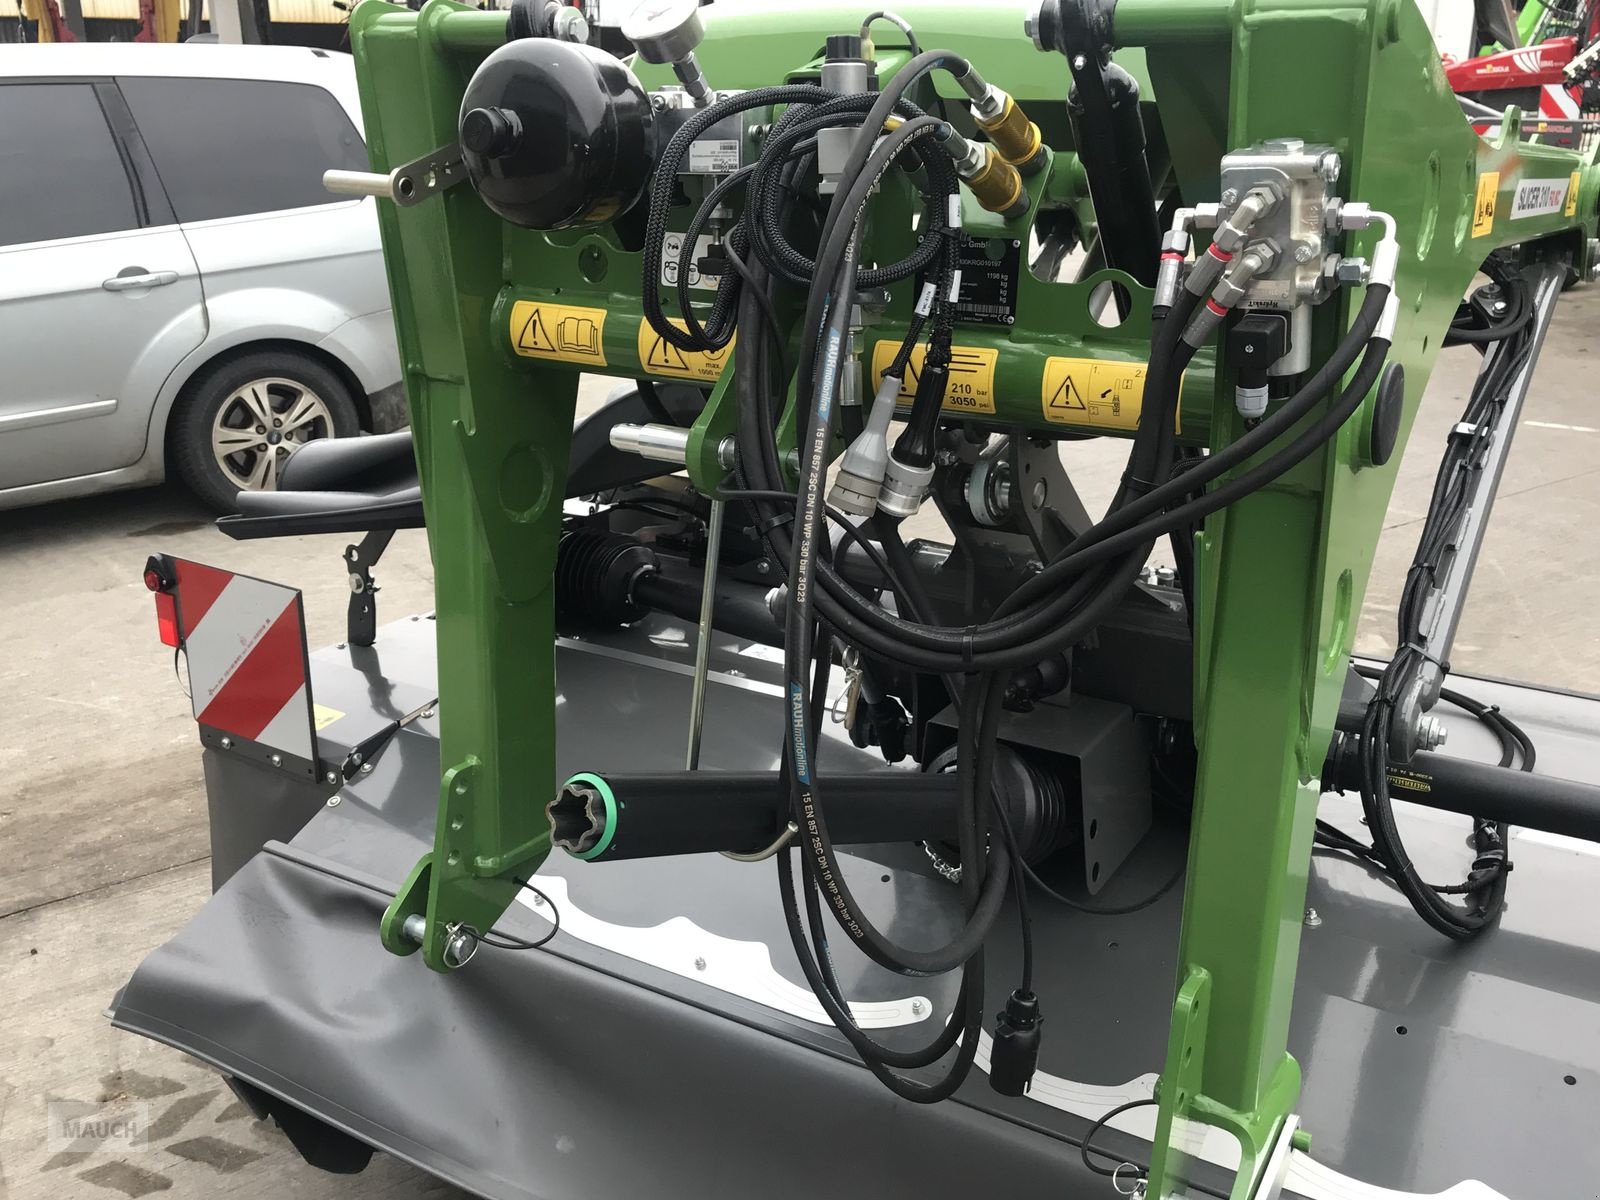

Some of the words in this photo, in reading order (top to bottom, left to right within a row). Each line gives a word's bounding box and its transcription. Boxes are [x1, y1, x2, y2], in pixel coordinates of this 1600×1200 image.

[820, 336, 840, 412] RAUHmotionline
[952, 383, 971, 394] 210
[949, 396, 976, 406] 3050
[816, 427, 825, 438] 15
[815, 439, 824, 453] EN
[812, 456, 822, 471] 857
[808, 473, 818, 492] 2SC
[806, 493, 816, 508] DN
[804, 509, 813, 521] 10
[803, 522, 812, 539] WP
[800, 540, 810, 557] 330
[799, 558, 808, 576] bar
[792, 693, 806, 776] RAUHmotionline
[802, 792, 812, 803] 15
[804, 804, 814, 818] EN
[807, 820, 818, 836] 857
[812, 836, 824, 855] 2SC
[817, 855, 828, 870] DN
[822, 870, 832, 881] 10
[827, 880, 839, 895] WP
[832, 894, 845, 909] 330
[840, 907, 851, 921] bar
